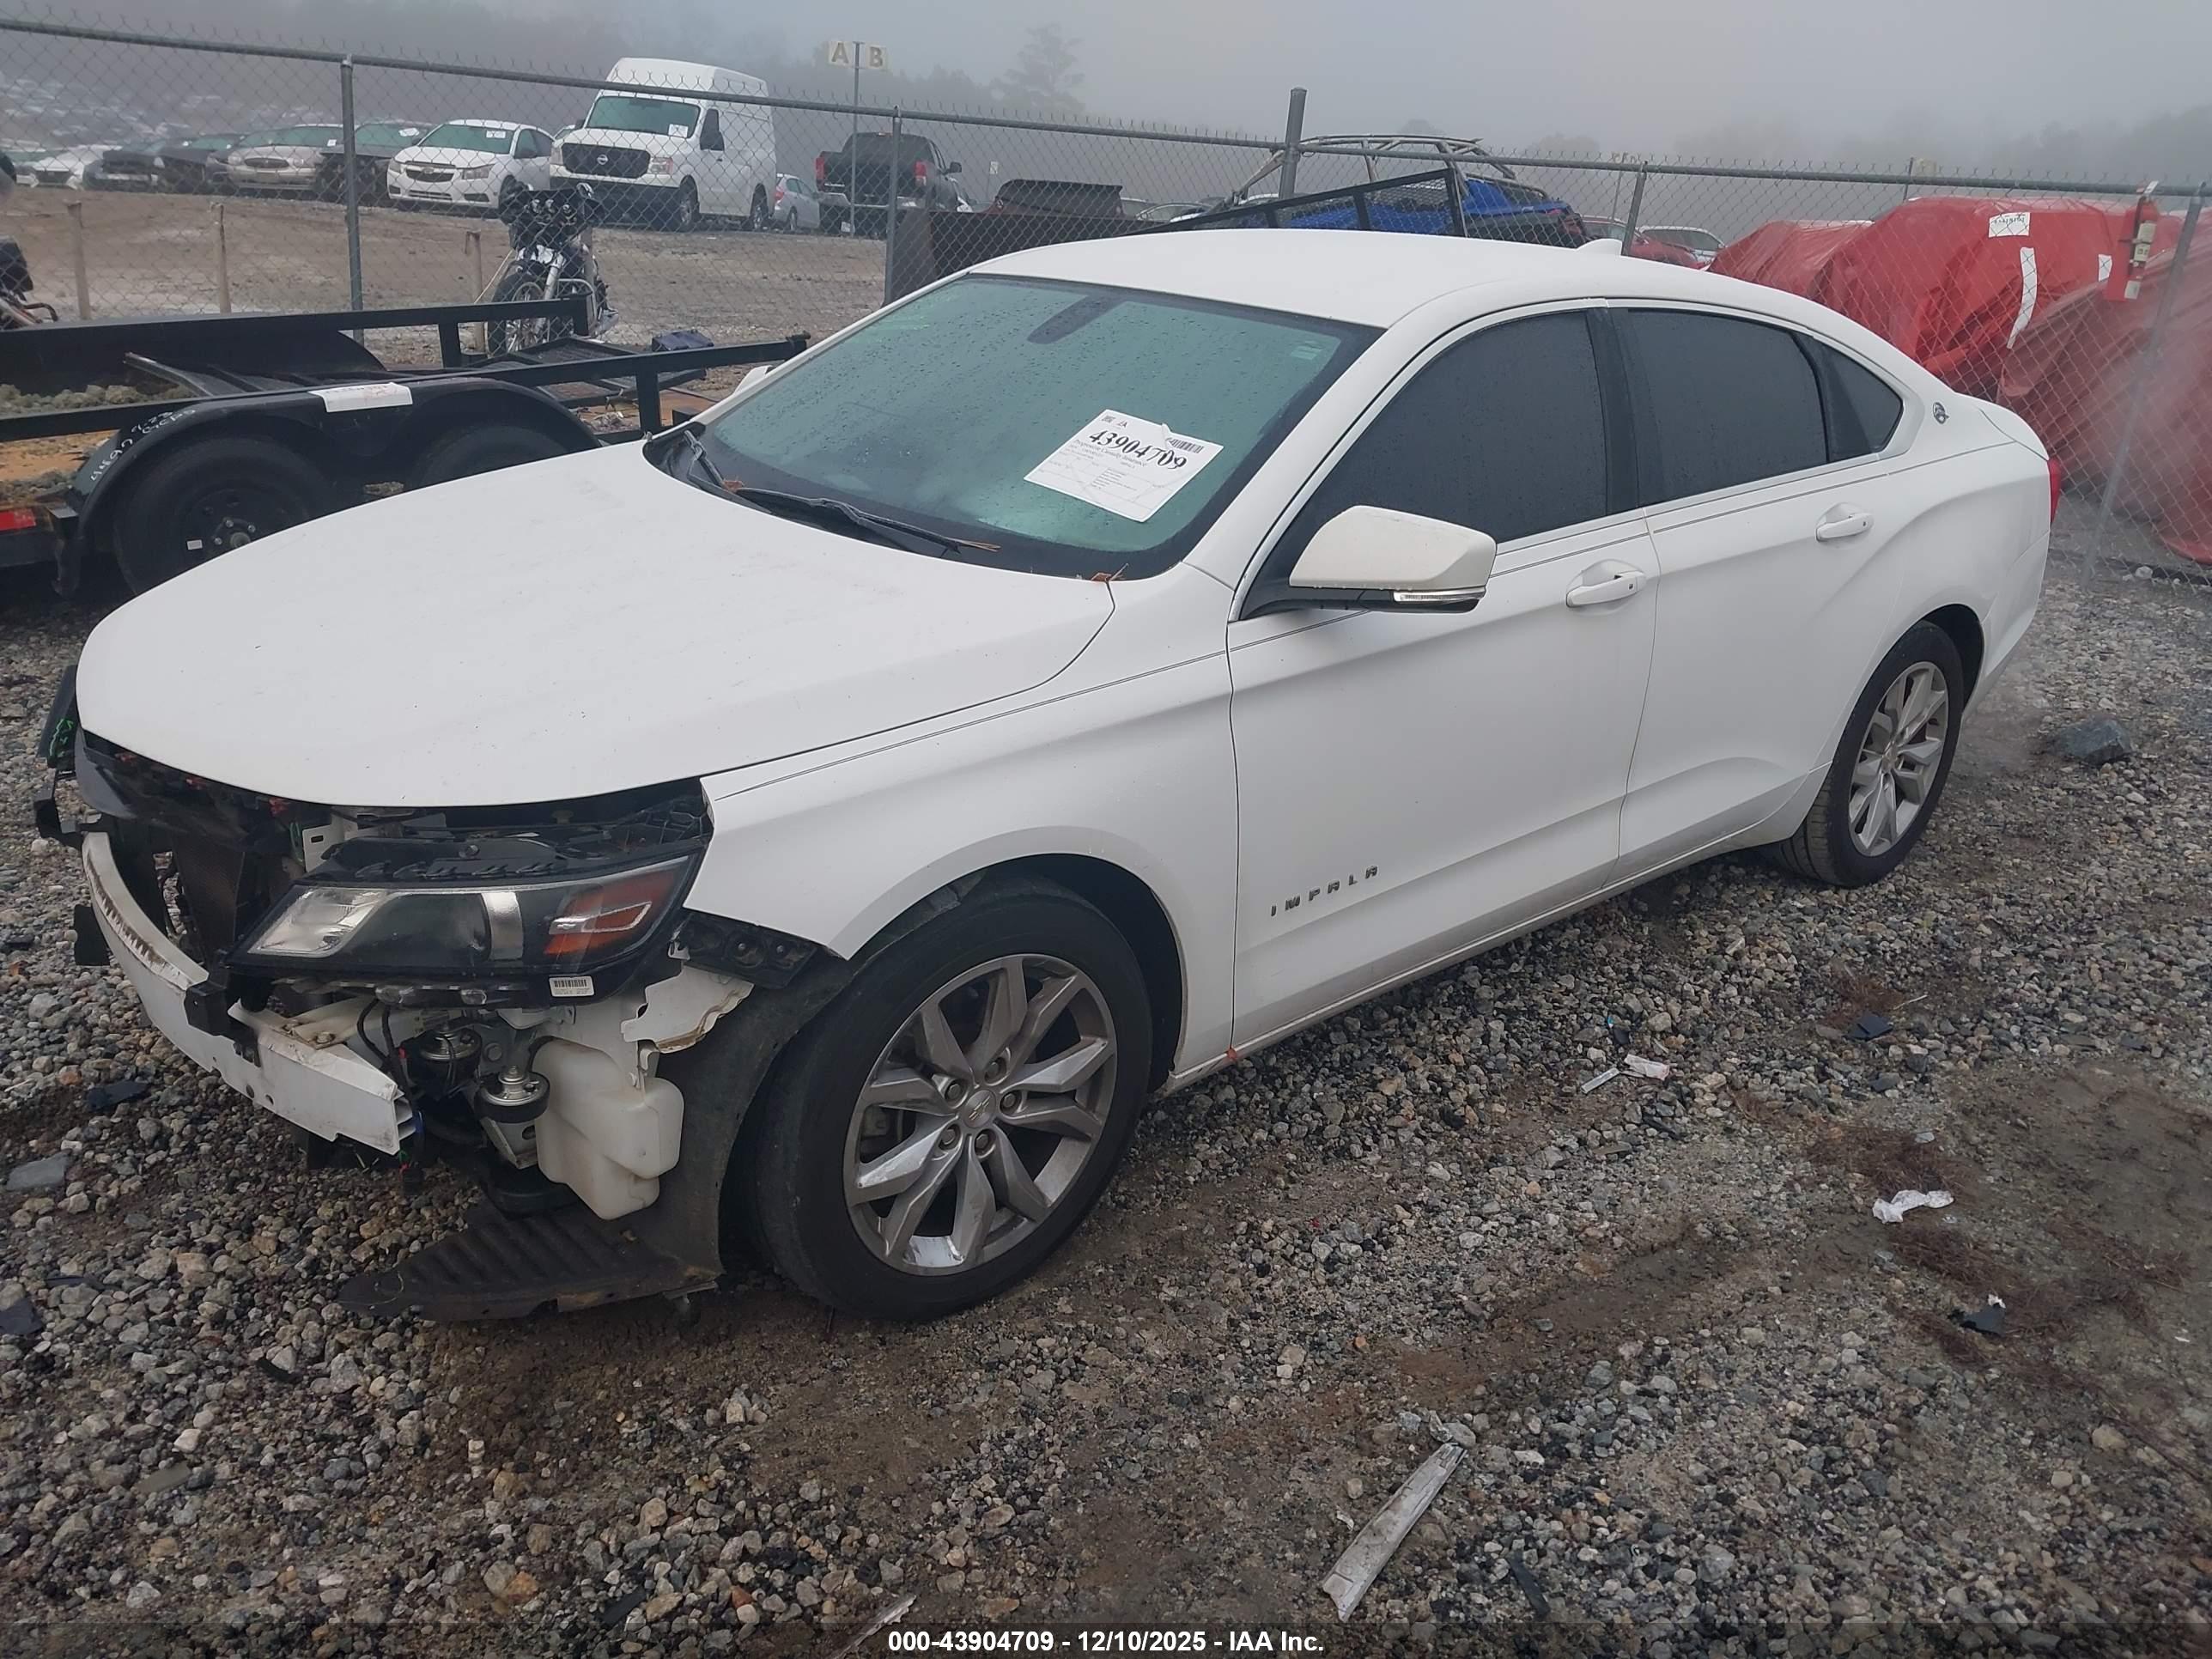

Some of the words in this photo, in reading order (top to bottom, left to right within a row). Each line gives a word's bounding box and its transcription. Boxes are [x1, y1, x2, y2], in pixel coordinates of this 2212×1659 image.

[831, 42, 849, 64] A
[869, 46, 884, 67] B
[1089, 429, 1188, 470] 43904709
[1270, 865, 1378, 917] IMPALA
